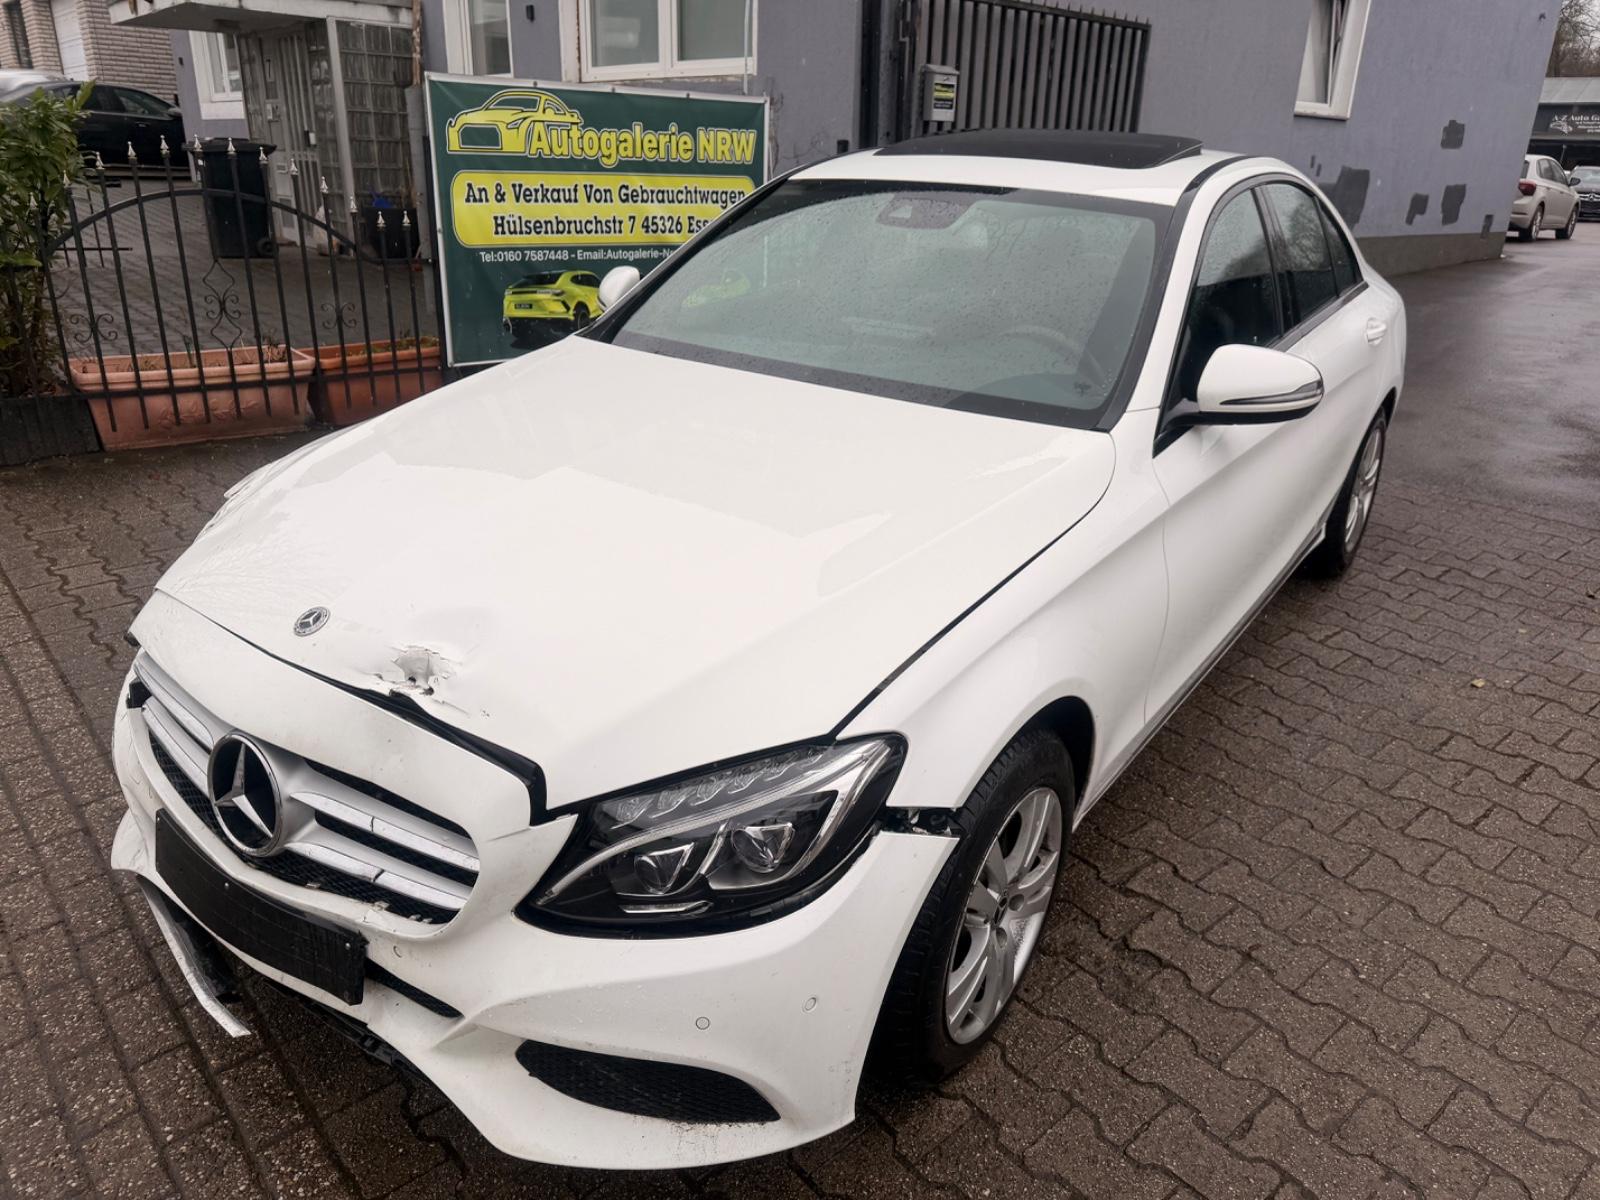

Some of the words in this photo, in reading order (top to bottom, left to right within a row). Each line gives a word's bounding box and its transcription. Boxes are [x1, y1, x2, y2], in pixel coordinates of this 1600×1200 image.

[529, 122, 694, 167] Autogalerie
[698, 128, 757, 164] NRW
[465, 182, 489, 203] An
[494, 182, 506, 203] &
[511, 183, 579, 204] Verkauf
[583, 184, 614, 204] Von
[618, 184, 746, 210] Gebrauchtwagen
[493, 214, 624, 235] Hülsenbruchstr
[628, 215, 637, 234] 7
[641, 215, 683, 234] 45326
[480, 251, 522, 262] Tel:0160
[525, 250, 569, 261] 7587448
